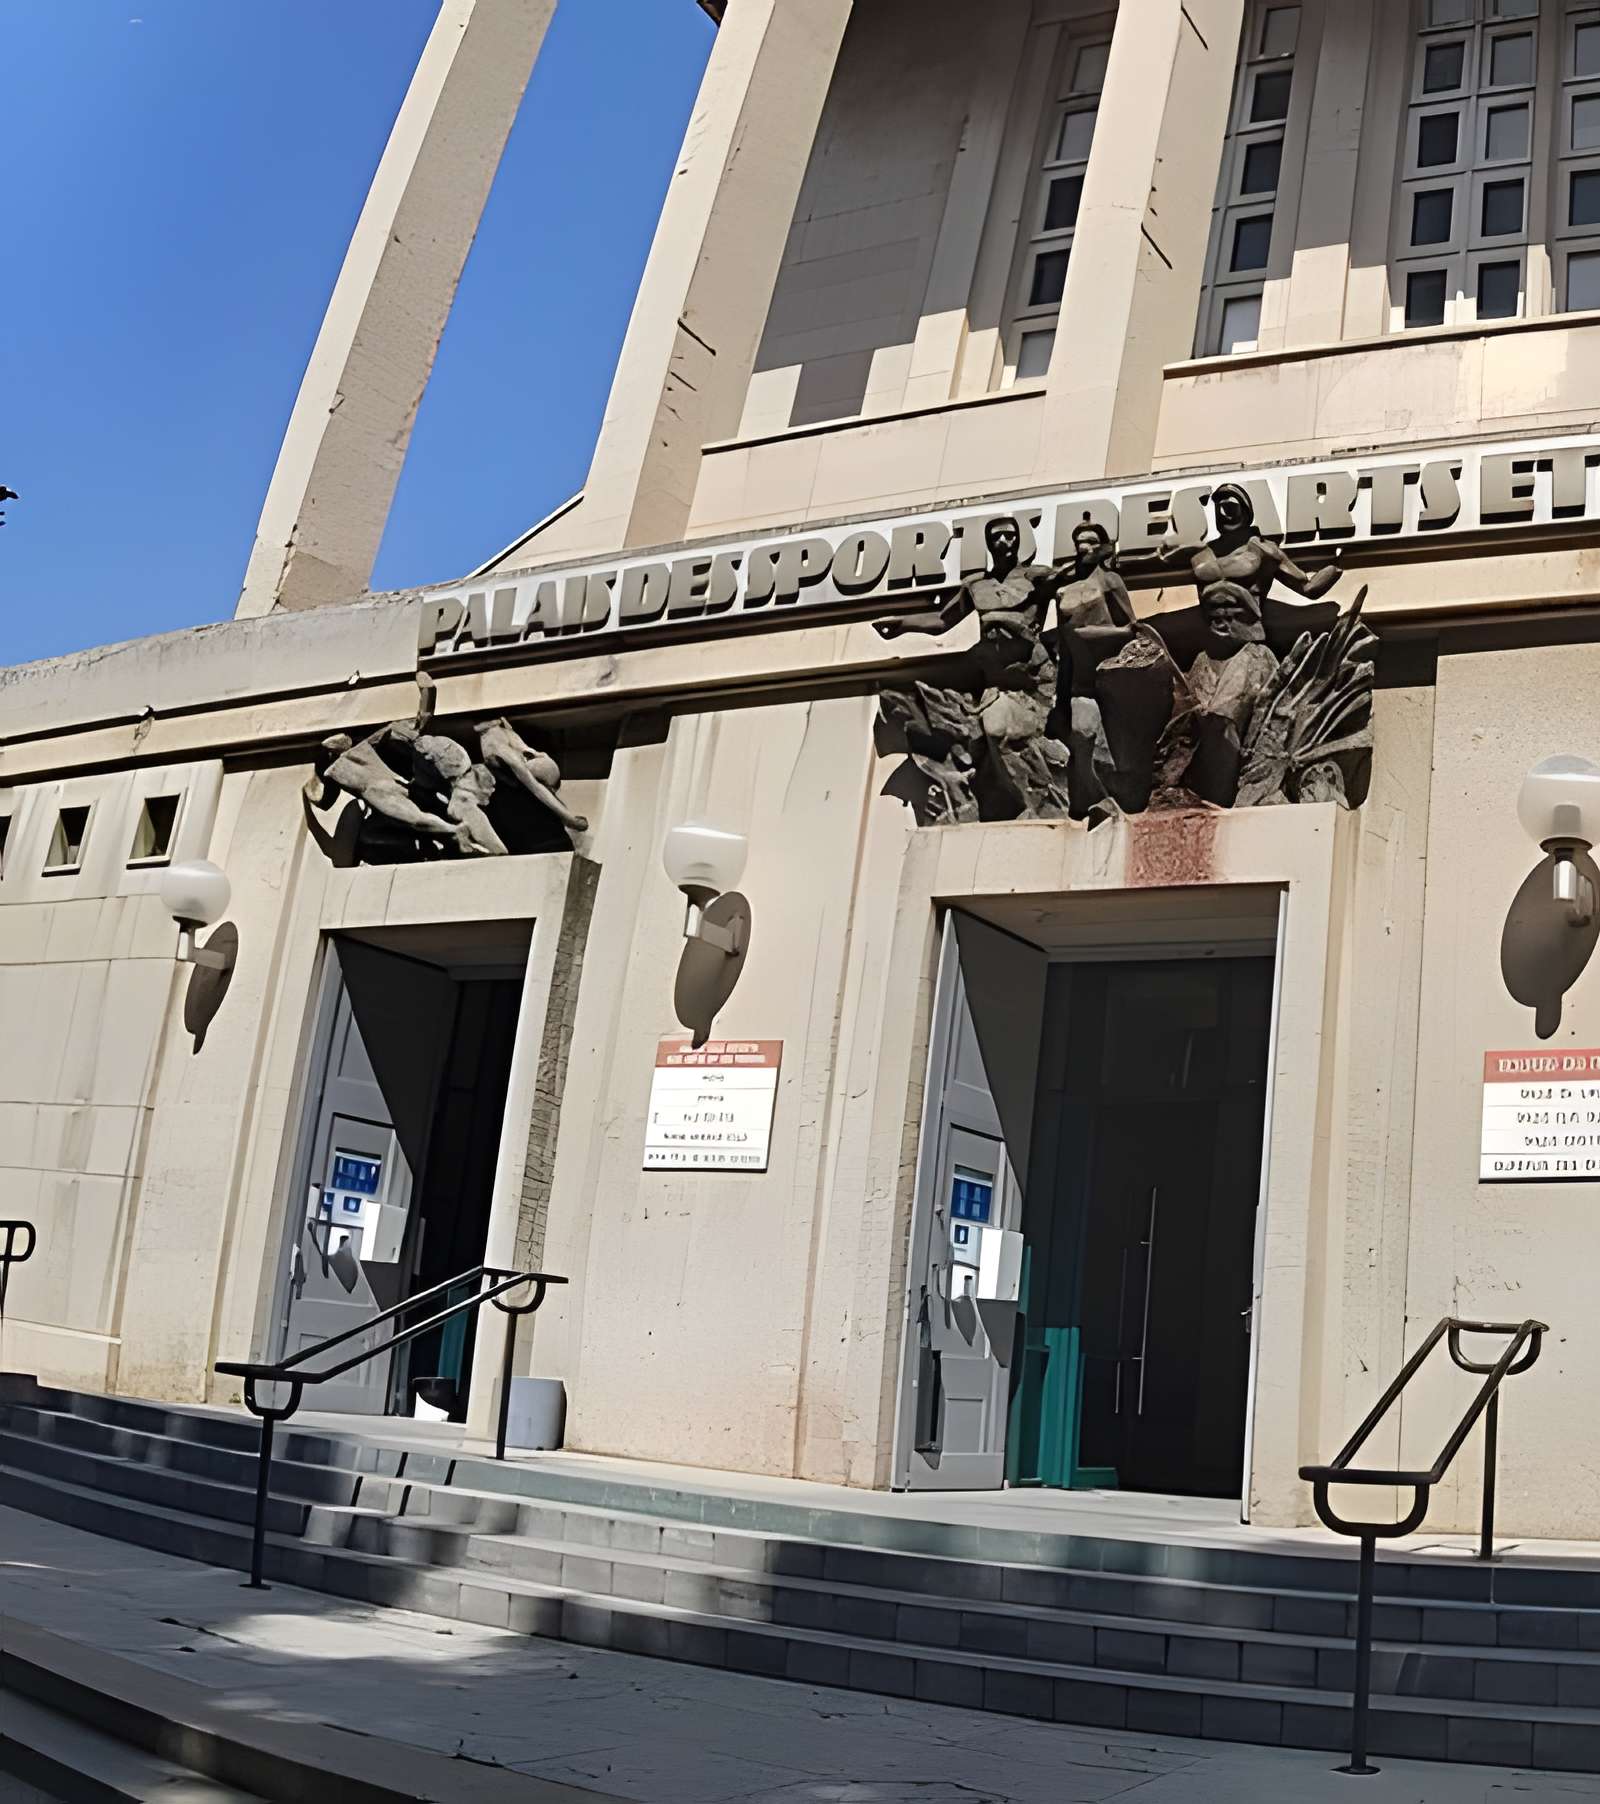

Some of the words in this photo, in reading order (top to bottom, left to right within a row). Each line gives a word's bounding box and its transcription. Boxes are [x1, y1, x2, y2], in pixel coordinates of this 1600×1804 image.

[418, 571, 618, 656] PALAIS
[619, 551, 746, 627] DES
[1052, 485, 1214, 566] DES
